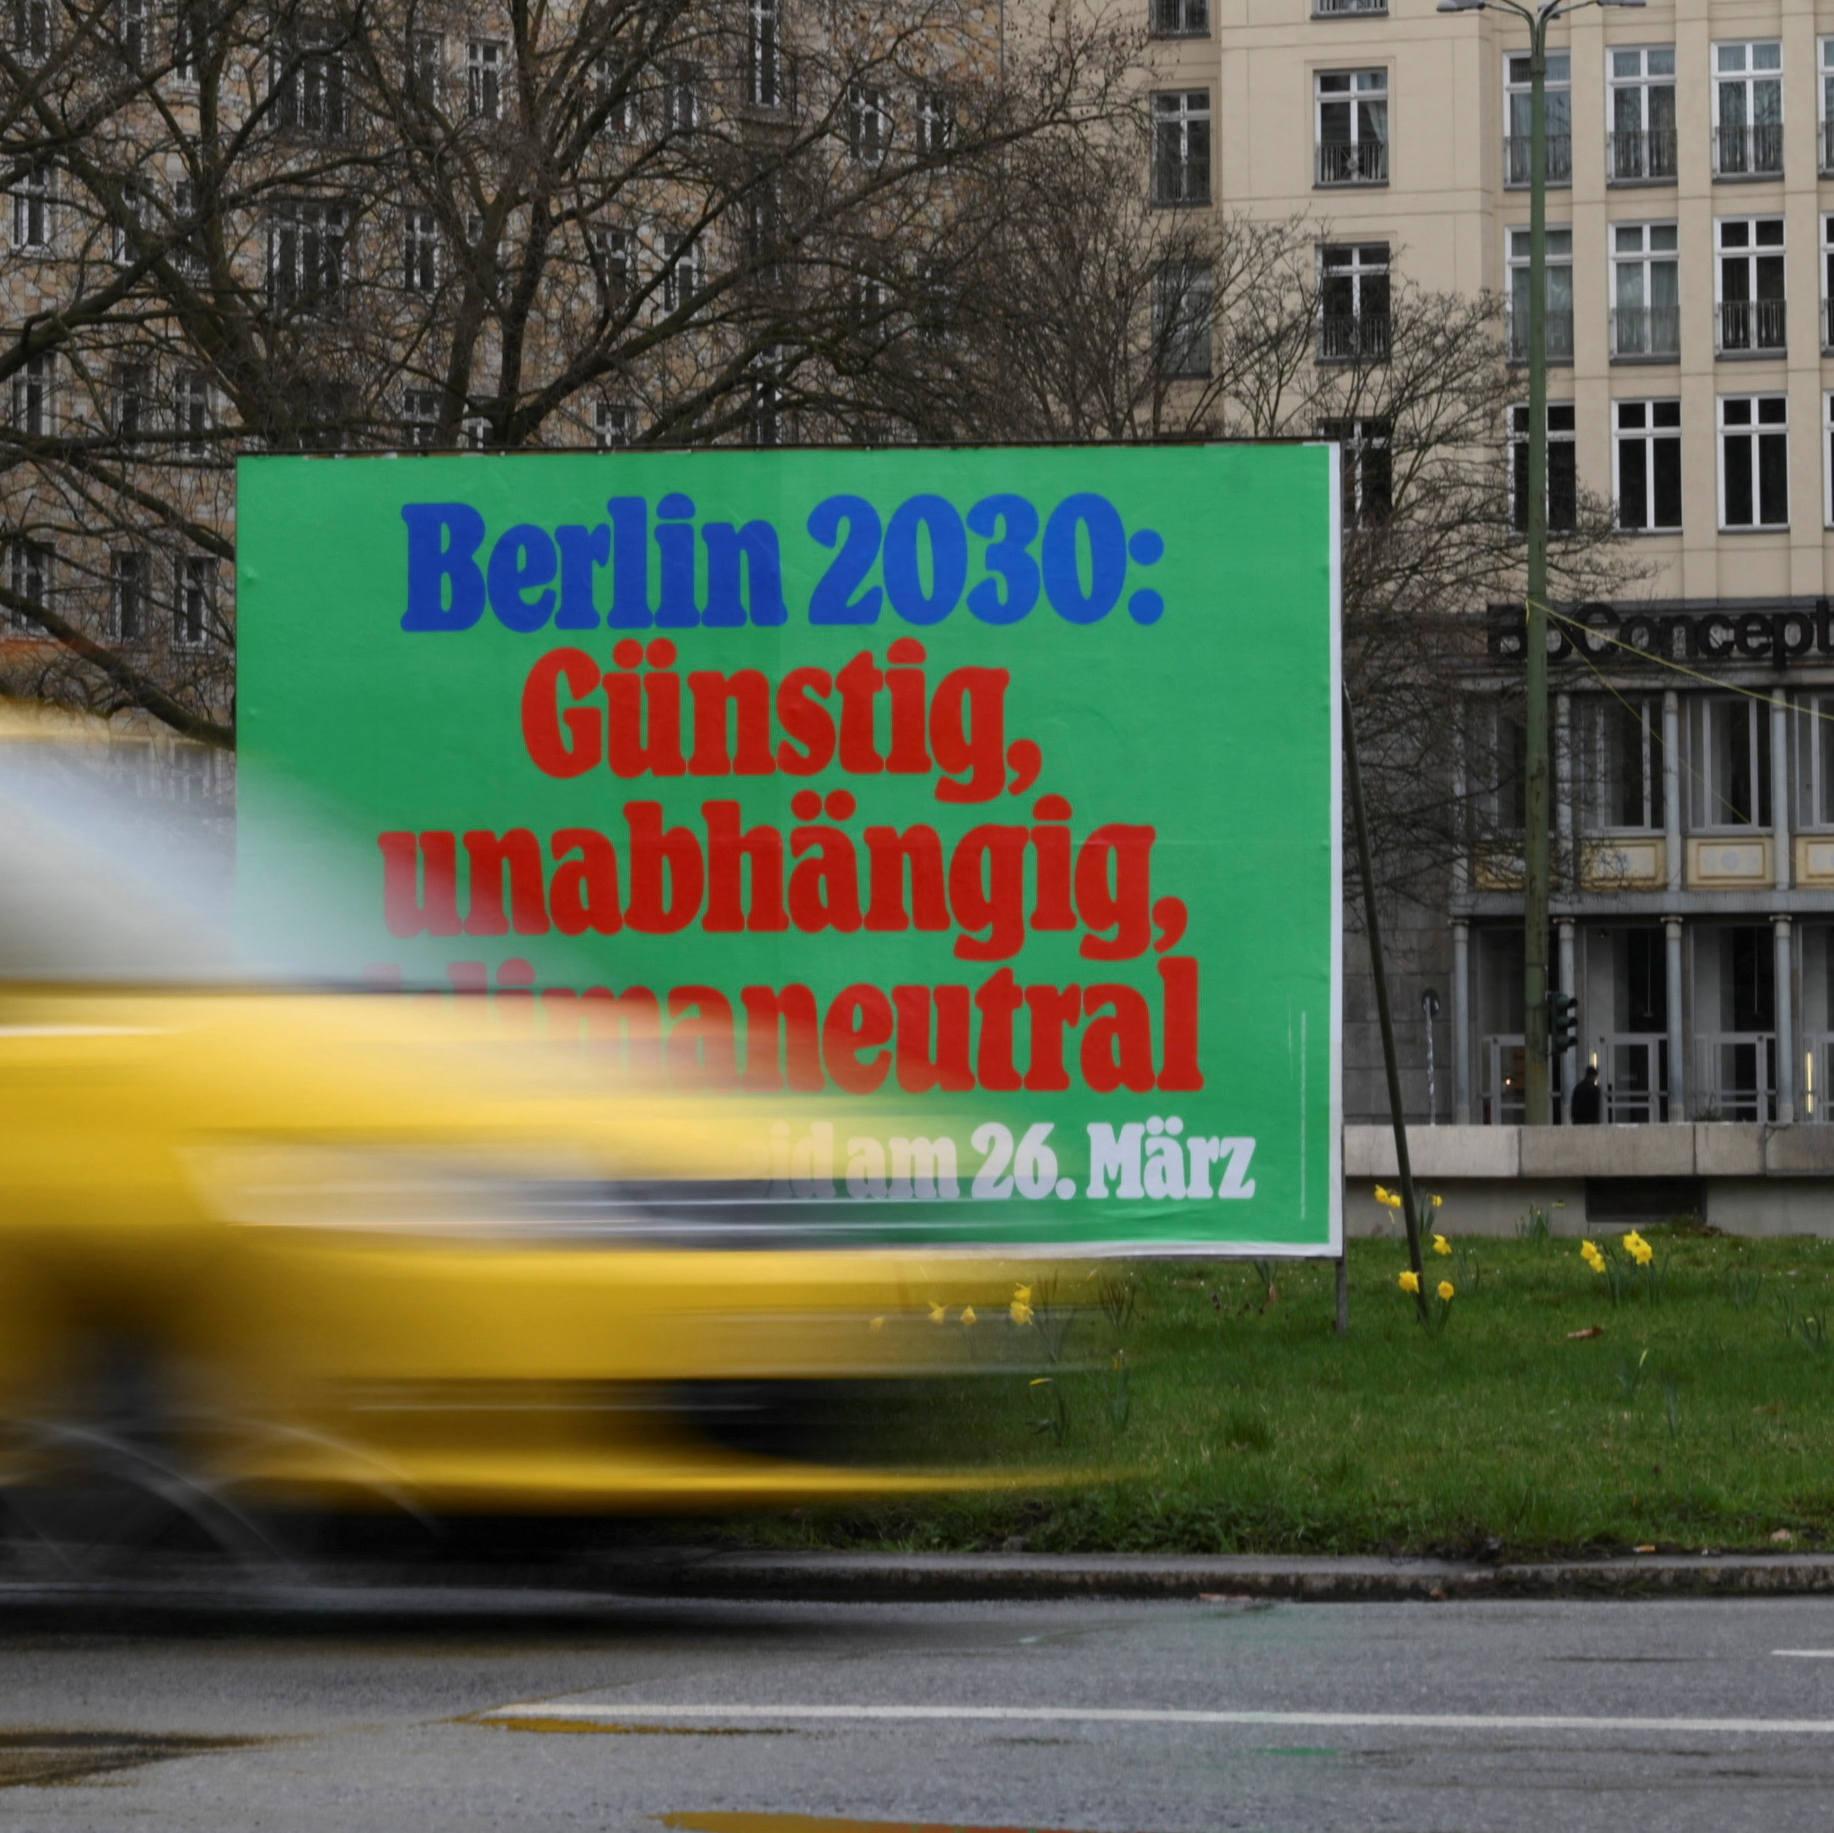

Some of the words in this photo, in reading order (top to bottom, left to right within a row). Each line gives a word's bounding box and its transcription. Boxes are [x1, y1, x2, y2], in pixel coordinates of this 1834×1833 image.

[401, 493, 788, 633] Berlin
[807, 493, 1165, 627] 2030:
[521, 637, 1043, 805] Günstig,
[378, 789, 1189, 962] unabhängig,
[846, 1136, 959, 1199] am
[970, 1119, 1077, 1200] 26.
[1086, 1116, 1257, 1200] März
